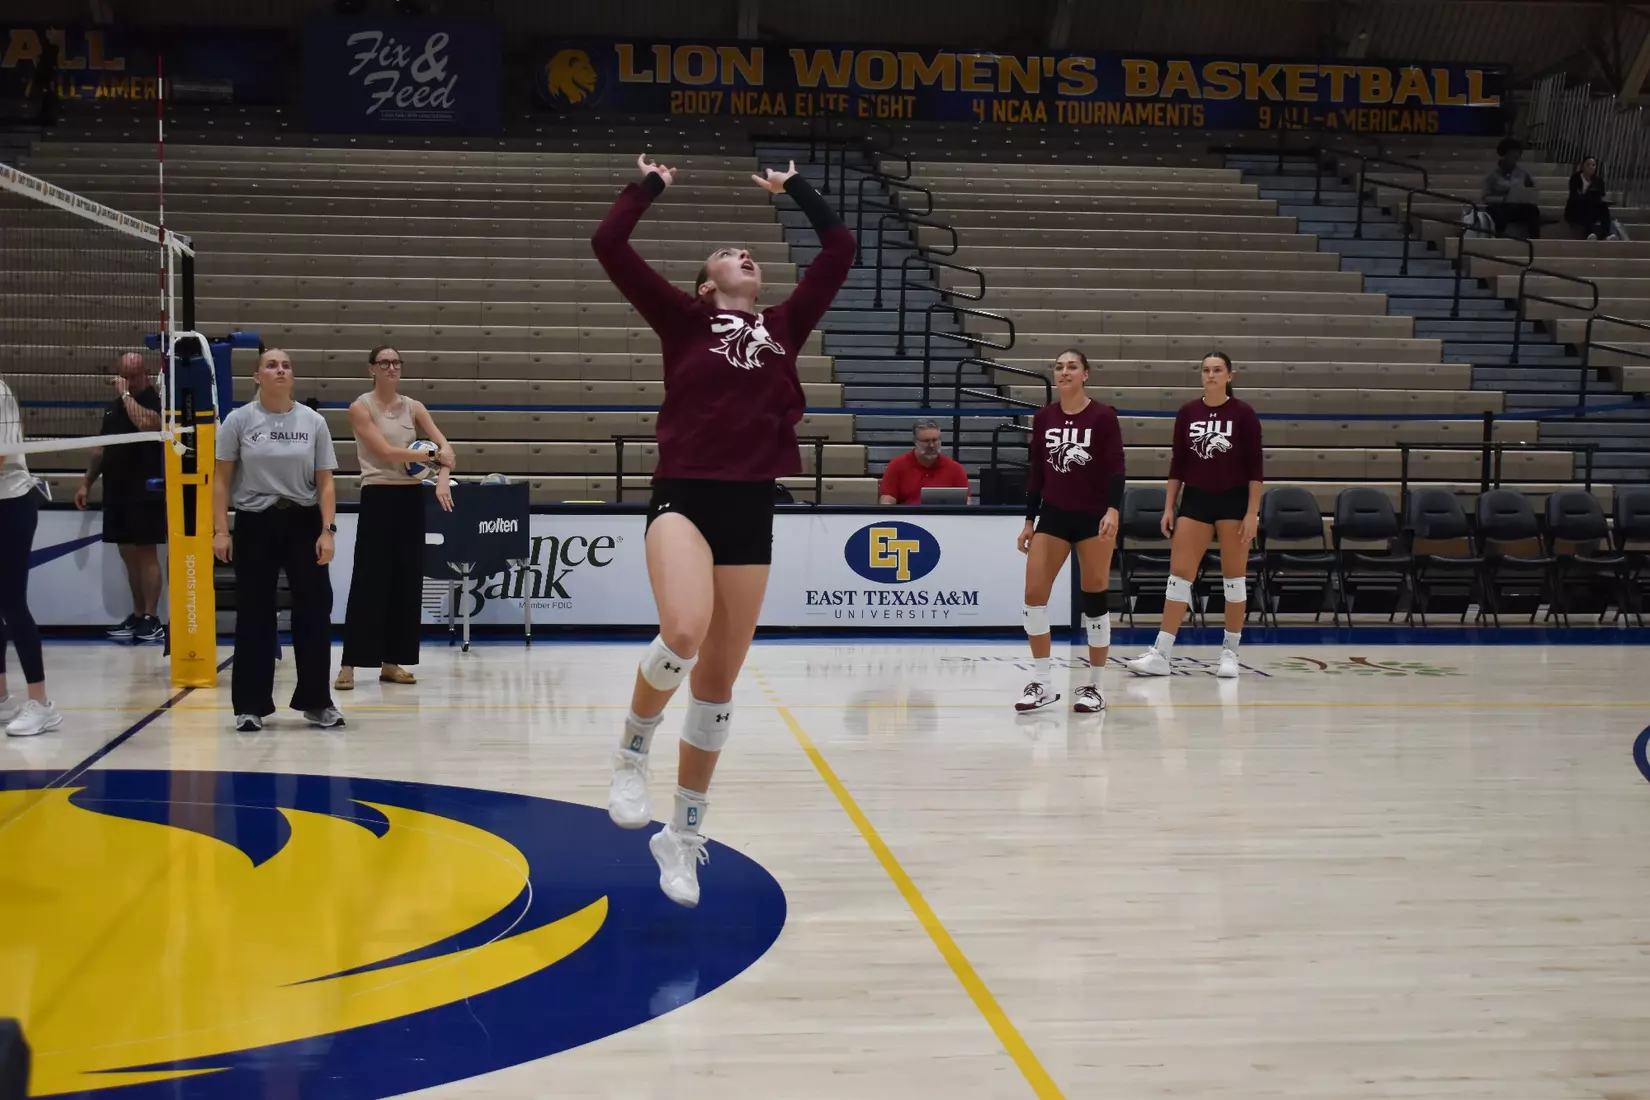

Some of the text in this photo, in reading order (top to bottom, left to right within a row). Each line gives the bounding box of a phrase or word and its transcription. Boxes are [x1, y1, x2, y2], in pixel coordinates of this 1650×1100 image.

[347, 30, 449, 83] Fix &
[615, 43, 1500, 109] LION WOMEN'S BASKETBALL
[364, 70, 458, 115] Feed
[671, 90, 724, 115] 2007
[731, 91, 787, 117] NCAA
[971, 98, 1205, 128] 4 NCAA TOURNAMENTS
[1258, 105, 1271, 130] 9
[270, 431, 309, 441] SALUKI
[1044, 427, 1093, 448] SIU
[1189, 420, 1233, 437] SIU
[479, 517, 518, 534] molten
[869, 527, 920, 581] ET
[185, 554, 198, 634] sports imports
[805, 590, 980, 606] EAST TEXAS A&M
[834, 610, 951, 619] UNIVERSITY
